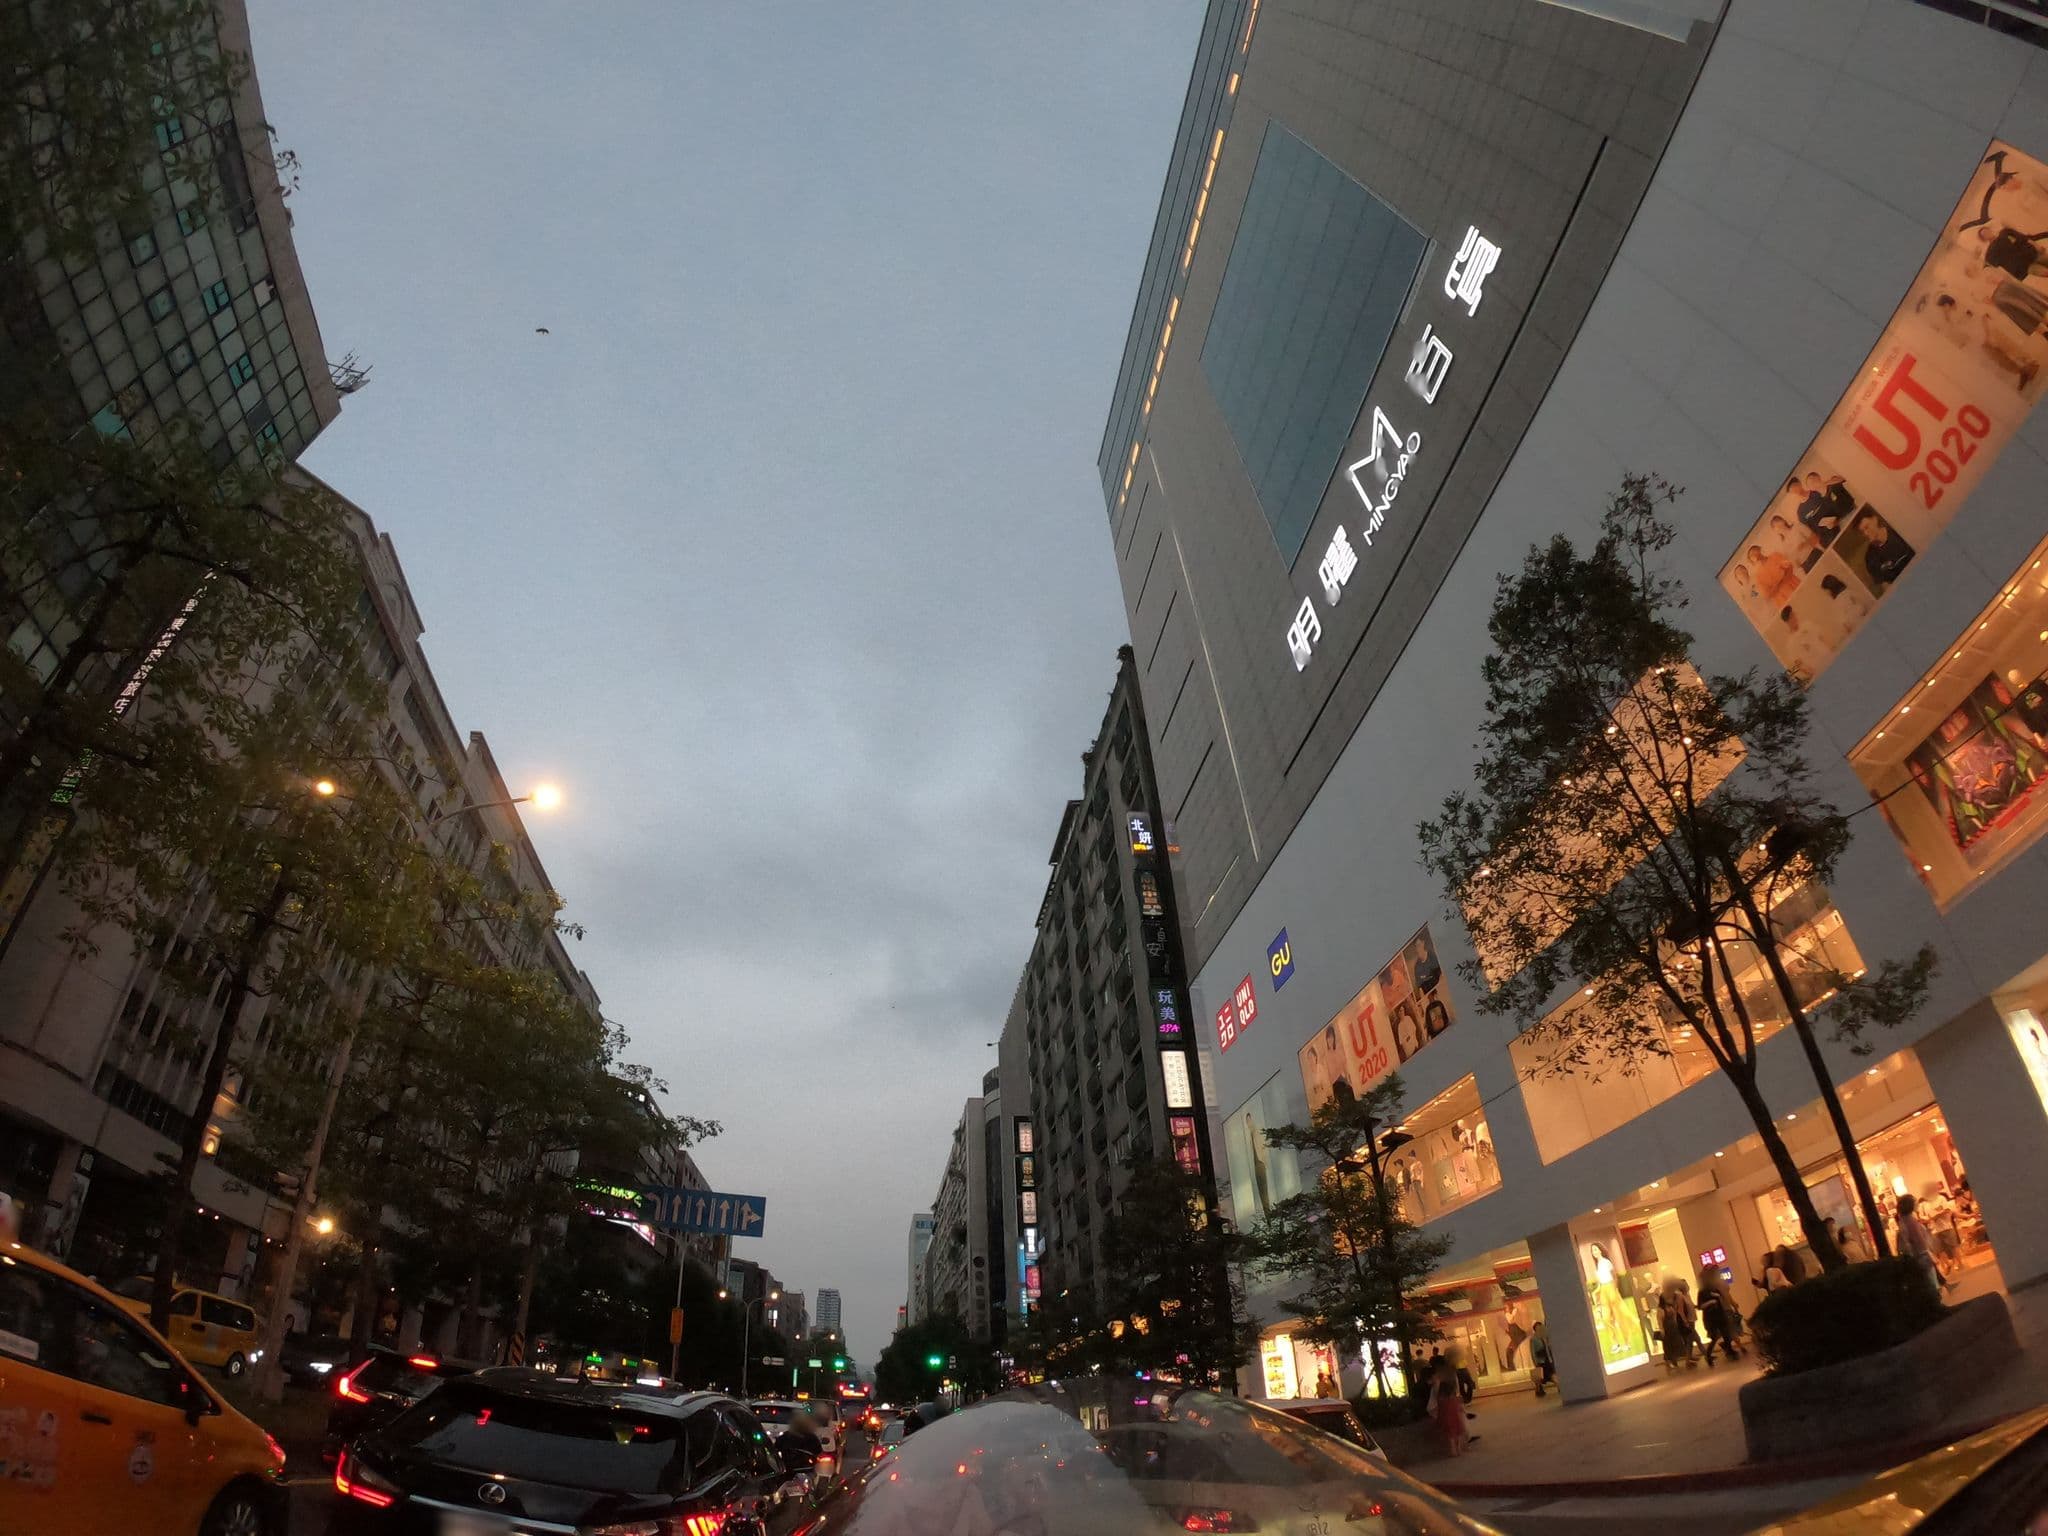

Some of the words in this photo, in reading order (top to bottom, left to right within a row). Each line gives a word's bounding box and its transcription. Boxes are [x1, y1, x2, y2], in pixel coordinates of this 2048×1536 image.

[1853, 352, 1949, 470] UT
[1286, 523, 1360, 672] 明曜
[1405, 224, 1503, 404] 百貨
[1909, 404, 1992, 510] 2020
[1363, 431, 1423, 547] MINGYAO
[1270, 941, 1291, 977] GU
[1157, 990, 1176, 1021] 玩美
[1236, 982, 1251, 1007] UNI
[1239, 999, 1255, 1025] QLO
[1159, 1023, 1180, 1033] SPA
[1349, 1004, 1378, 1059] UT
[1359, 1046, 1388, 1085] 2020
